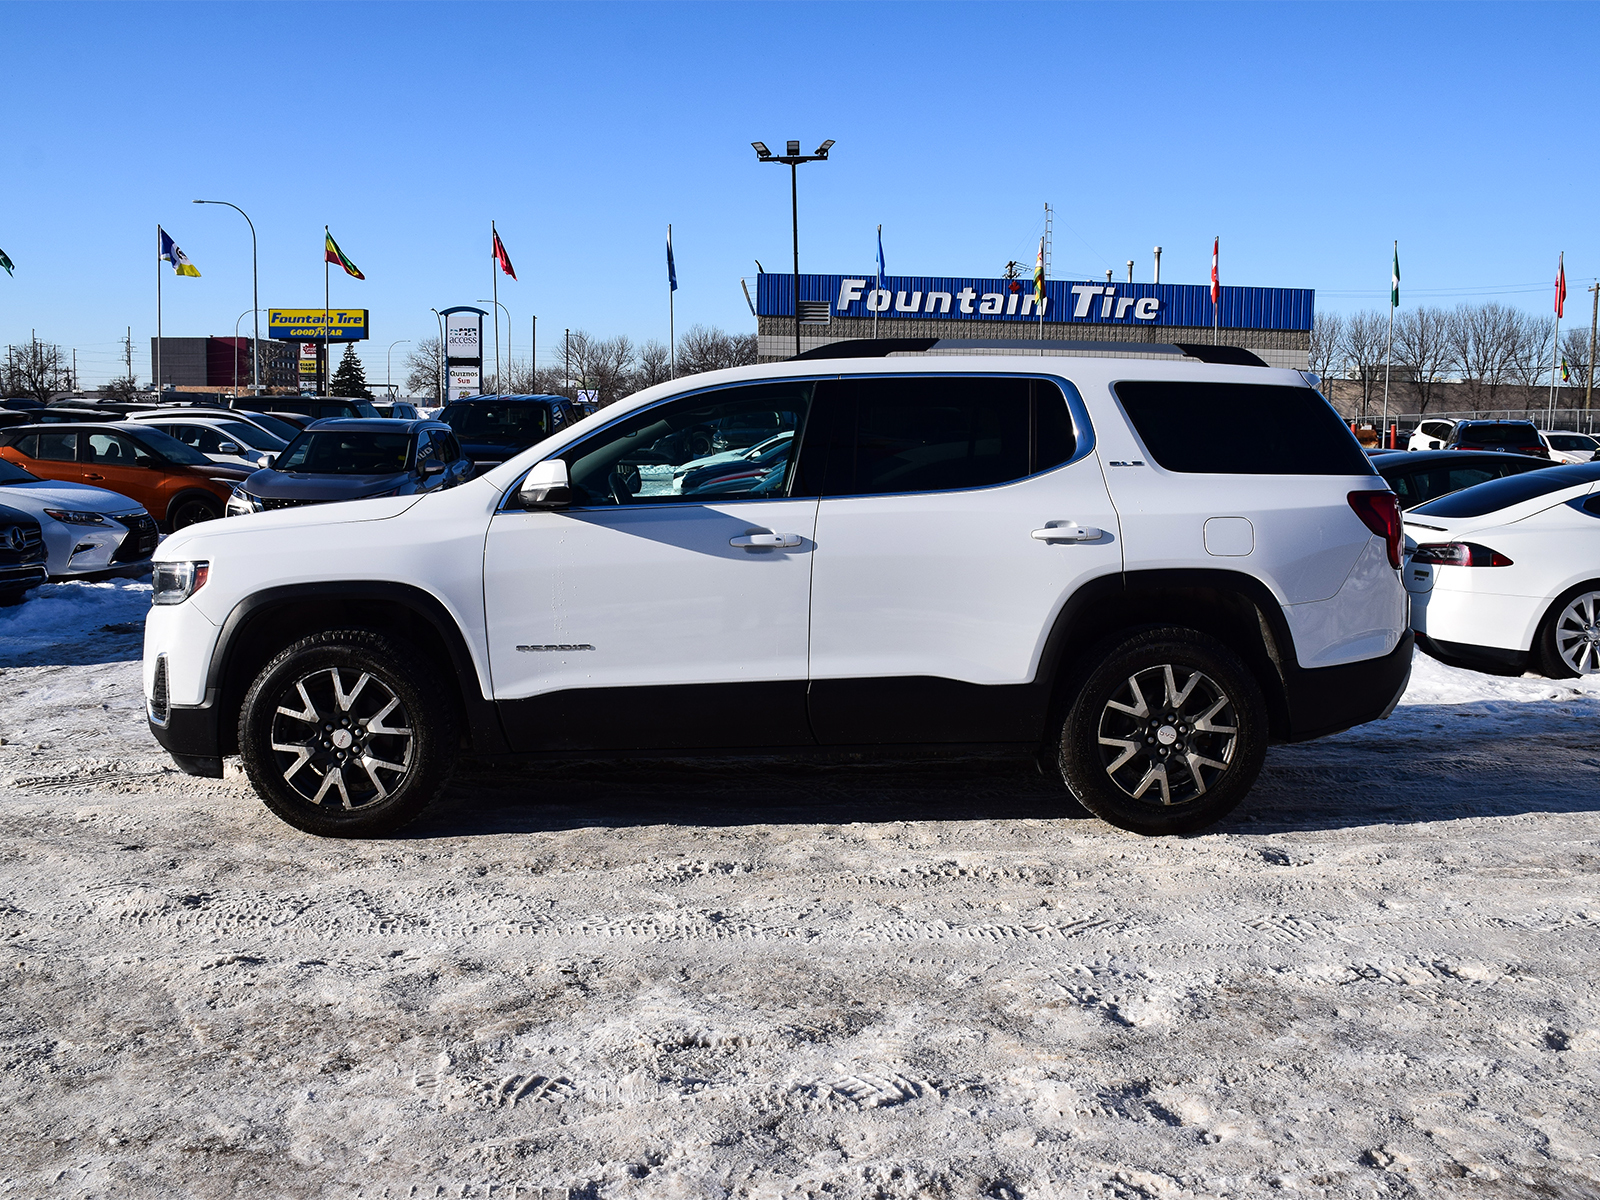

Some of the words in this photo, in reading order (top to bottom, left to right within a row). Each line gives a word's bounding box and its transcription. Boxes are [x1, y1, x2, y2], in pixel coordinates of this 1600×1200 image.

[837, 278, 1049, 316] Fountain
[1071, 285, 1160, 320] Tire
[271, 312, 334, 324] Fountain
[336, 312, 362, 324] Tire
[449, 336, 477, 344] access
